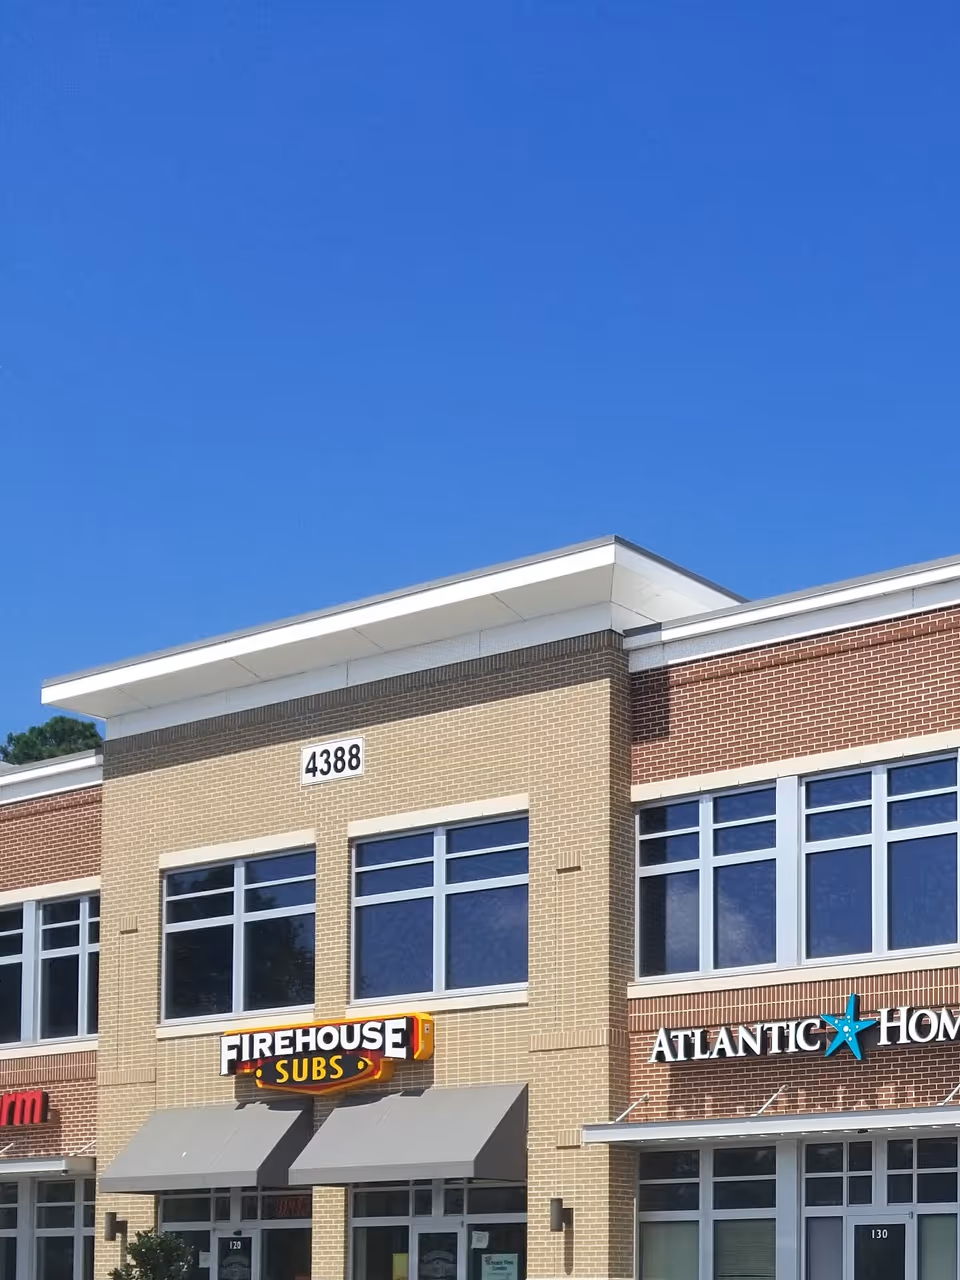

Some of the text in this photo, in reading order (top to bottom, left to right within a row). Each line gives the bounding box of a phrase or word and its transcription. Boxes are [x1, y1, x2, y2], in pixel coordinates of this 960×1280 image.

[305, 743, 361, 778] 4388
[220, 1016, 408, 1076] FIREHOUSE
[648, 1019, 822, 1063] ATLANTIC
[275, 1055, 343, 1083] SUBS
[230, 1241, 241, 1249] 120
[871, 1229, 888, 1239] 130
